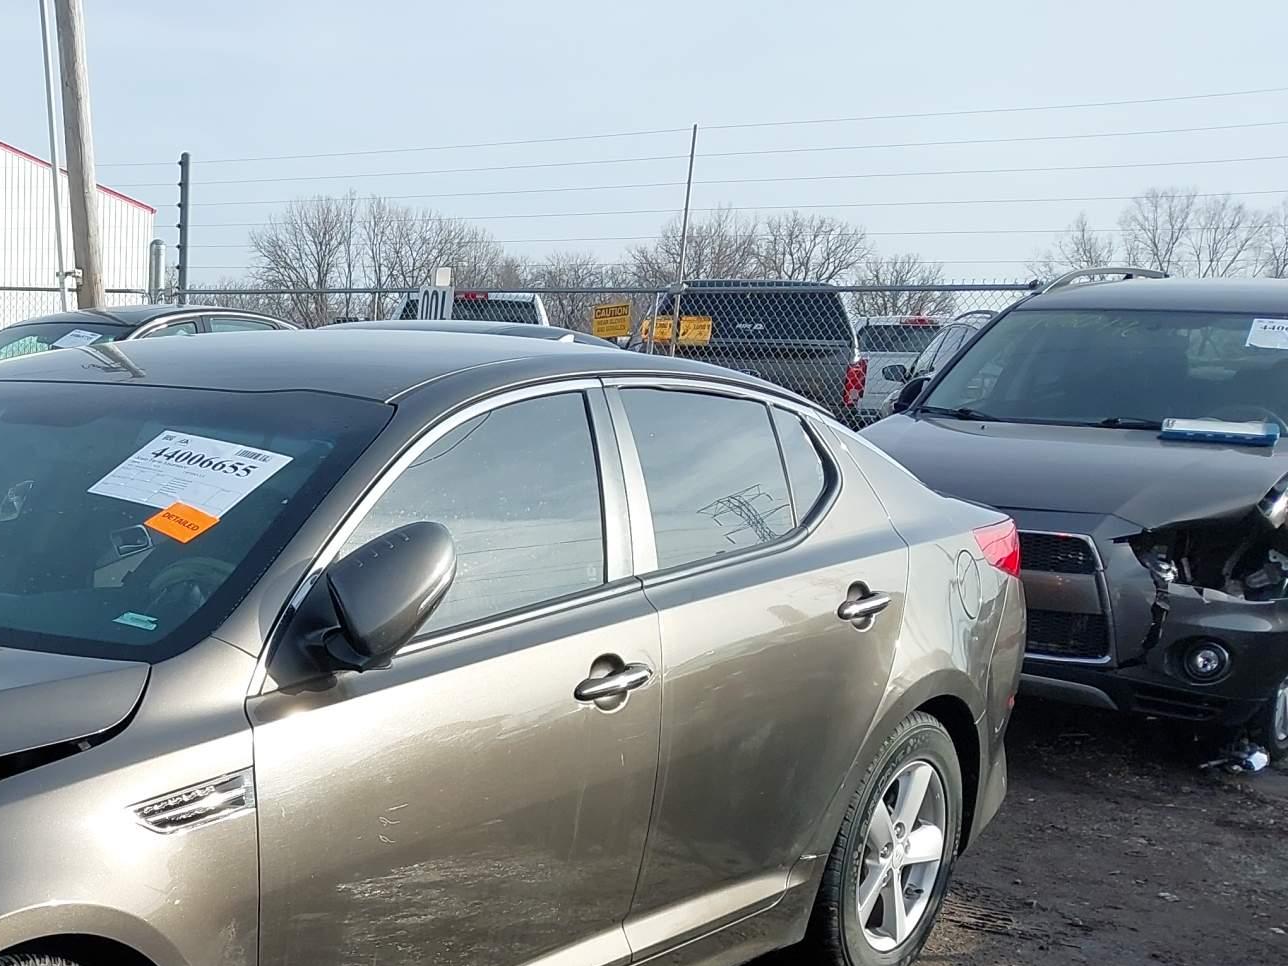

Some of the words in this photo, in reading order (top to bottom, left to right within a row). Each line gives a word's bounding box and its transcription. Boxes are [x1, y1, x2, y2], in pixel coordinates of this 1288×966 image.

[595, 306, 628, 318] CAUTION
[151, 446, 260, 478] 44006655
[161, 511, 200, 532] DETAILED
